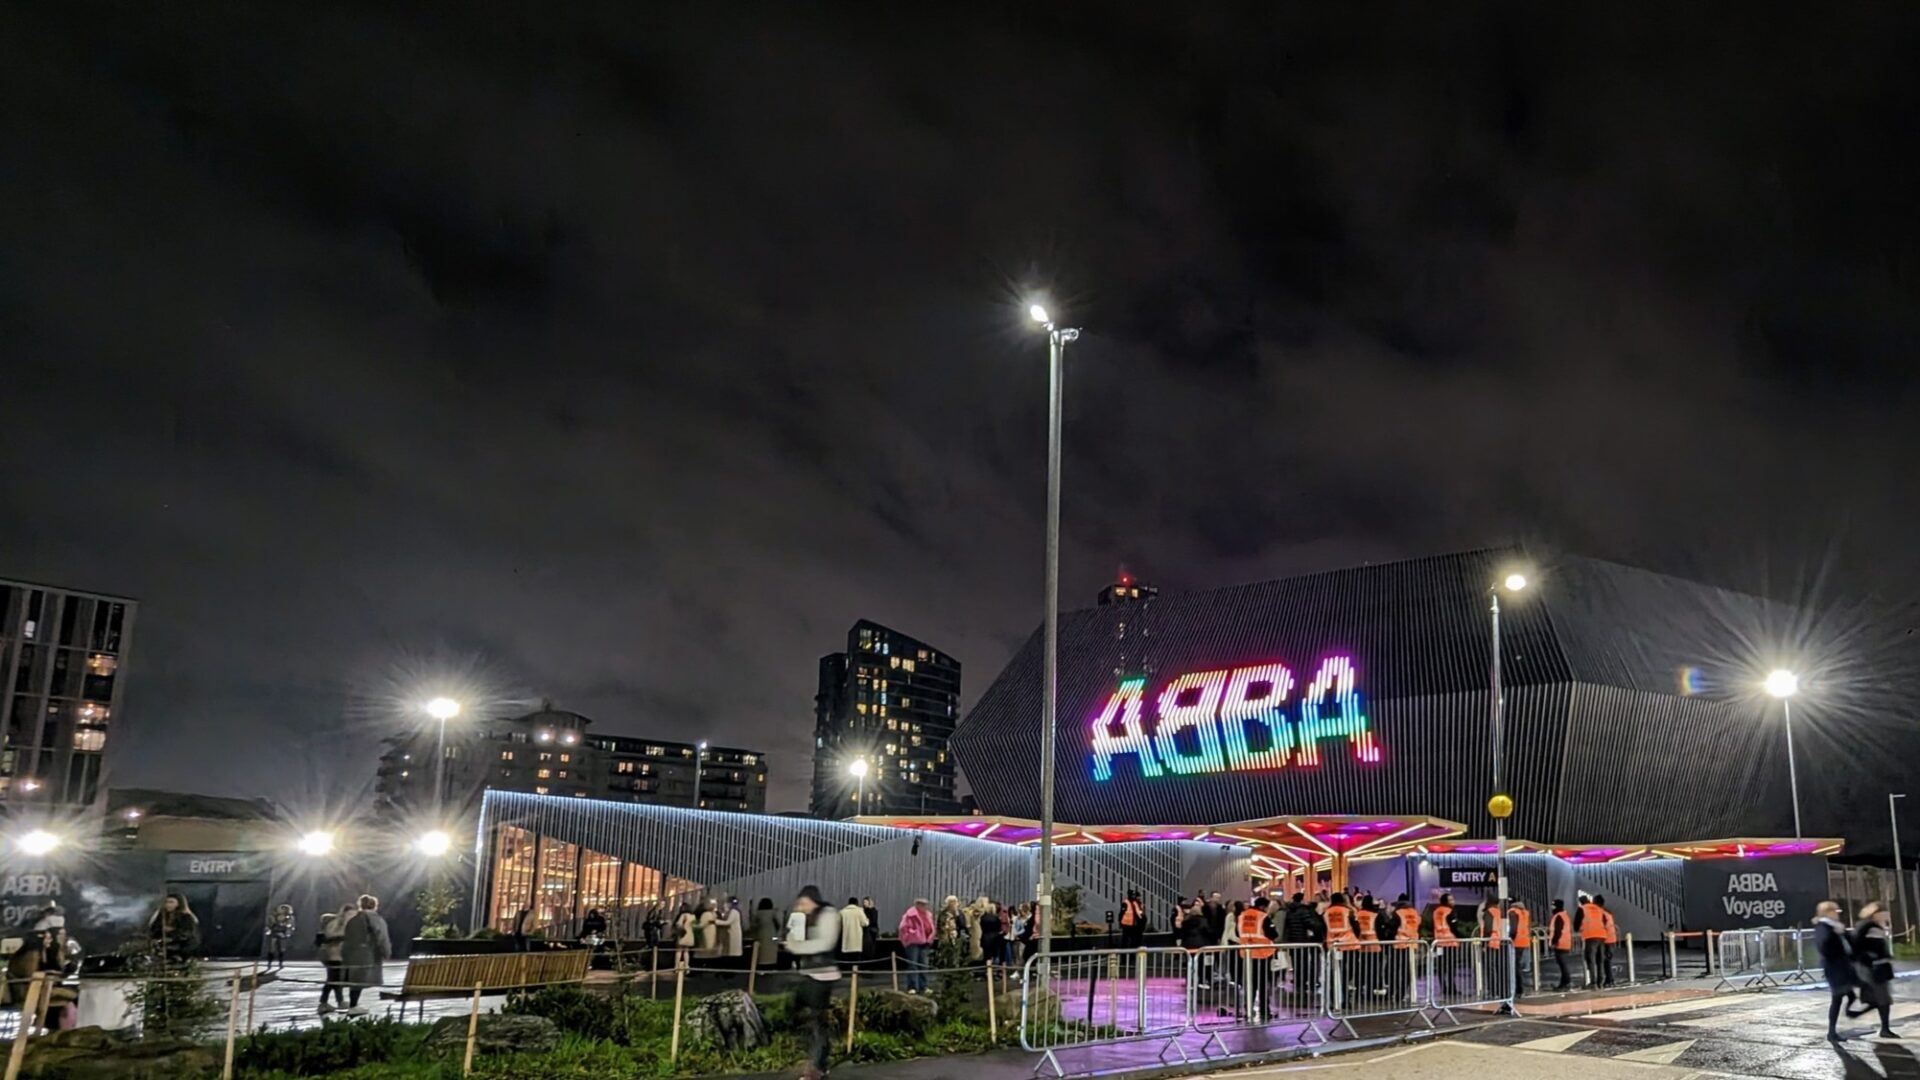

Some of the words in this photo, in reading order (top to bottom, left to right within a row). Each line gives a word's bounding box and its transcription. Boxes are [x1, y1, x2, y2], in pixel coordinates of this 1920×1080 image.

[1092, 655, 1379, 781] ABBA
[190, 860, 236, 873] ENTRY
[1452, 871, 1486, 883] ENTRY
[1488, 871, 1497, 883] A
[2, 874, 62, 896] ABBA
[1728, 872, 1778, 893] ABBA
[1722, 896, 1785, 919] Voyage
